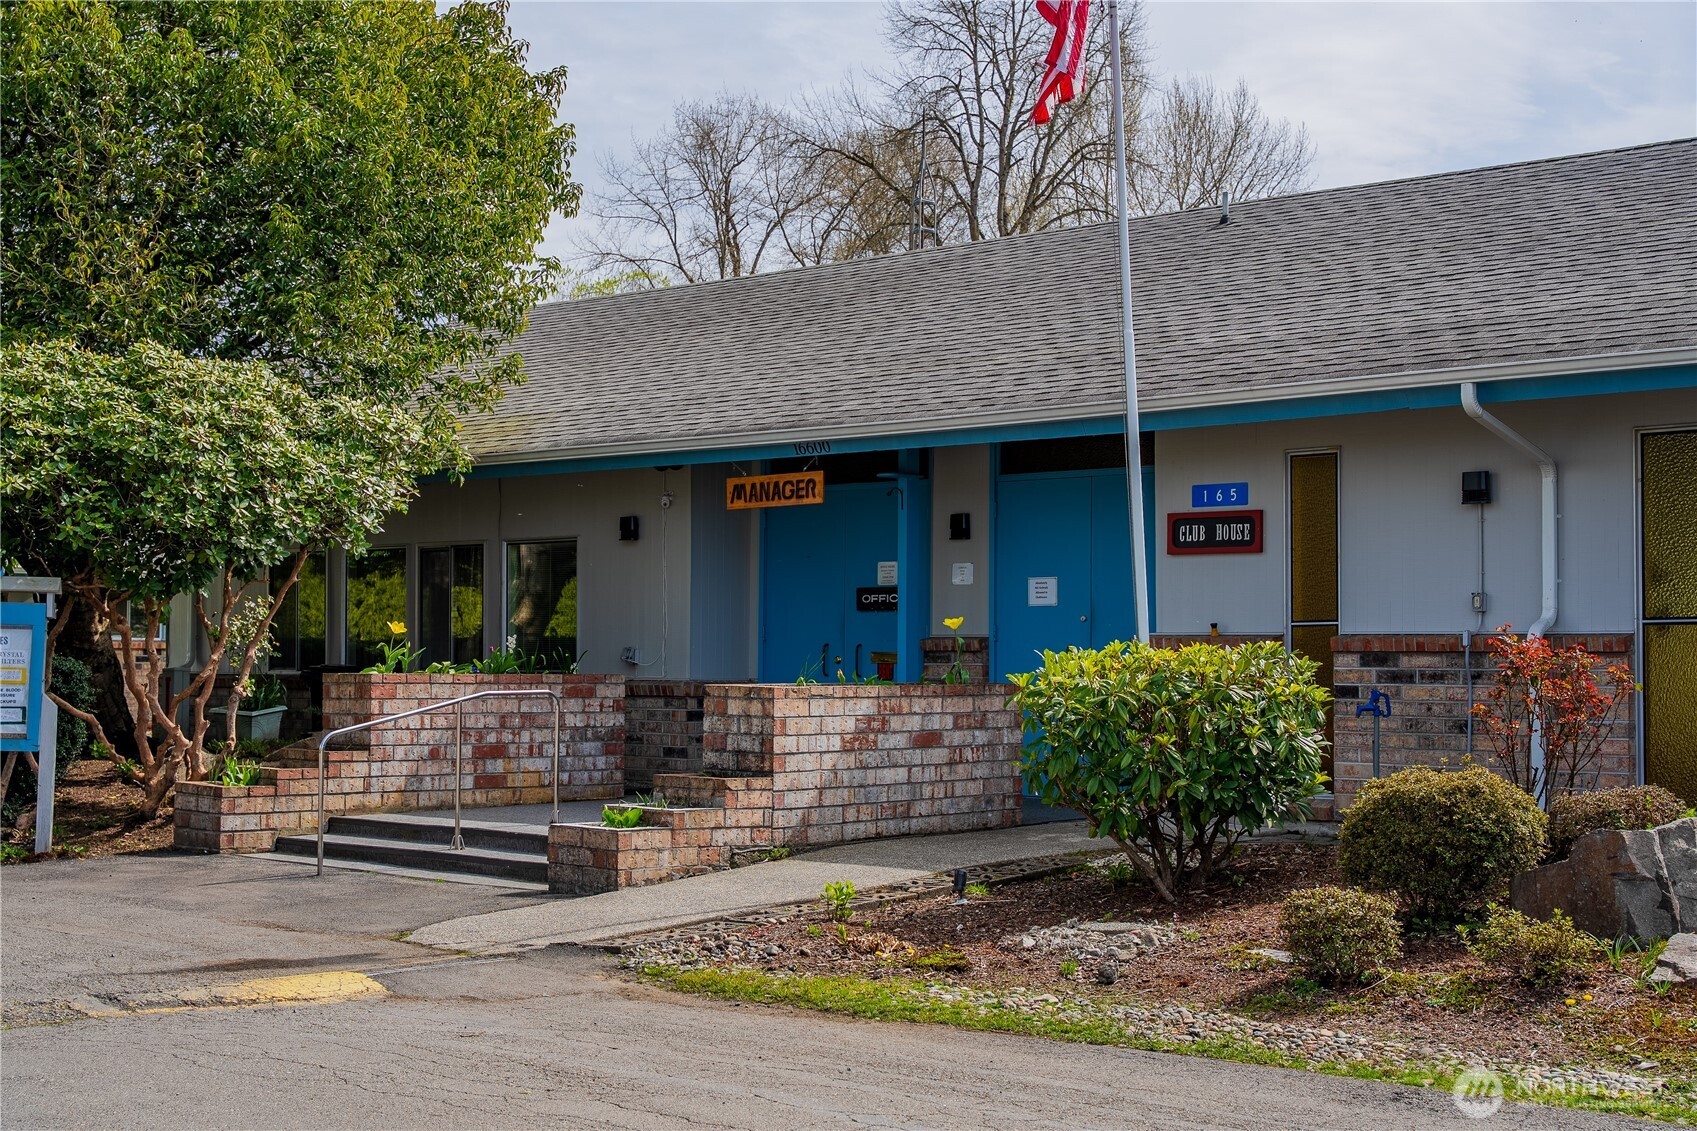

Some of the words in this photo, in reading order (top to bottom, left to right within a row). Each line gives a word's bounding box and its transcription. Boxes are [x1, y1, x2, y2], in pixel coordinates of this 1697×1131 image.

[792, 441, 831, 456] 16600
[730, 478, 817, 504] MANAGER
[1179, 525, 1206, 542] CLUB
[1215, 523, 1250, 541] HOUSE
[862, 594, 898, 603] OFFIC
